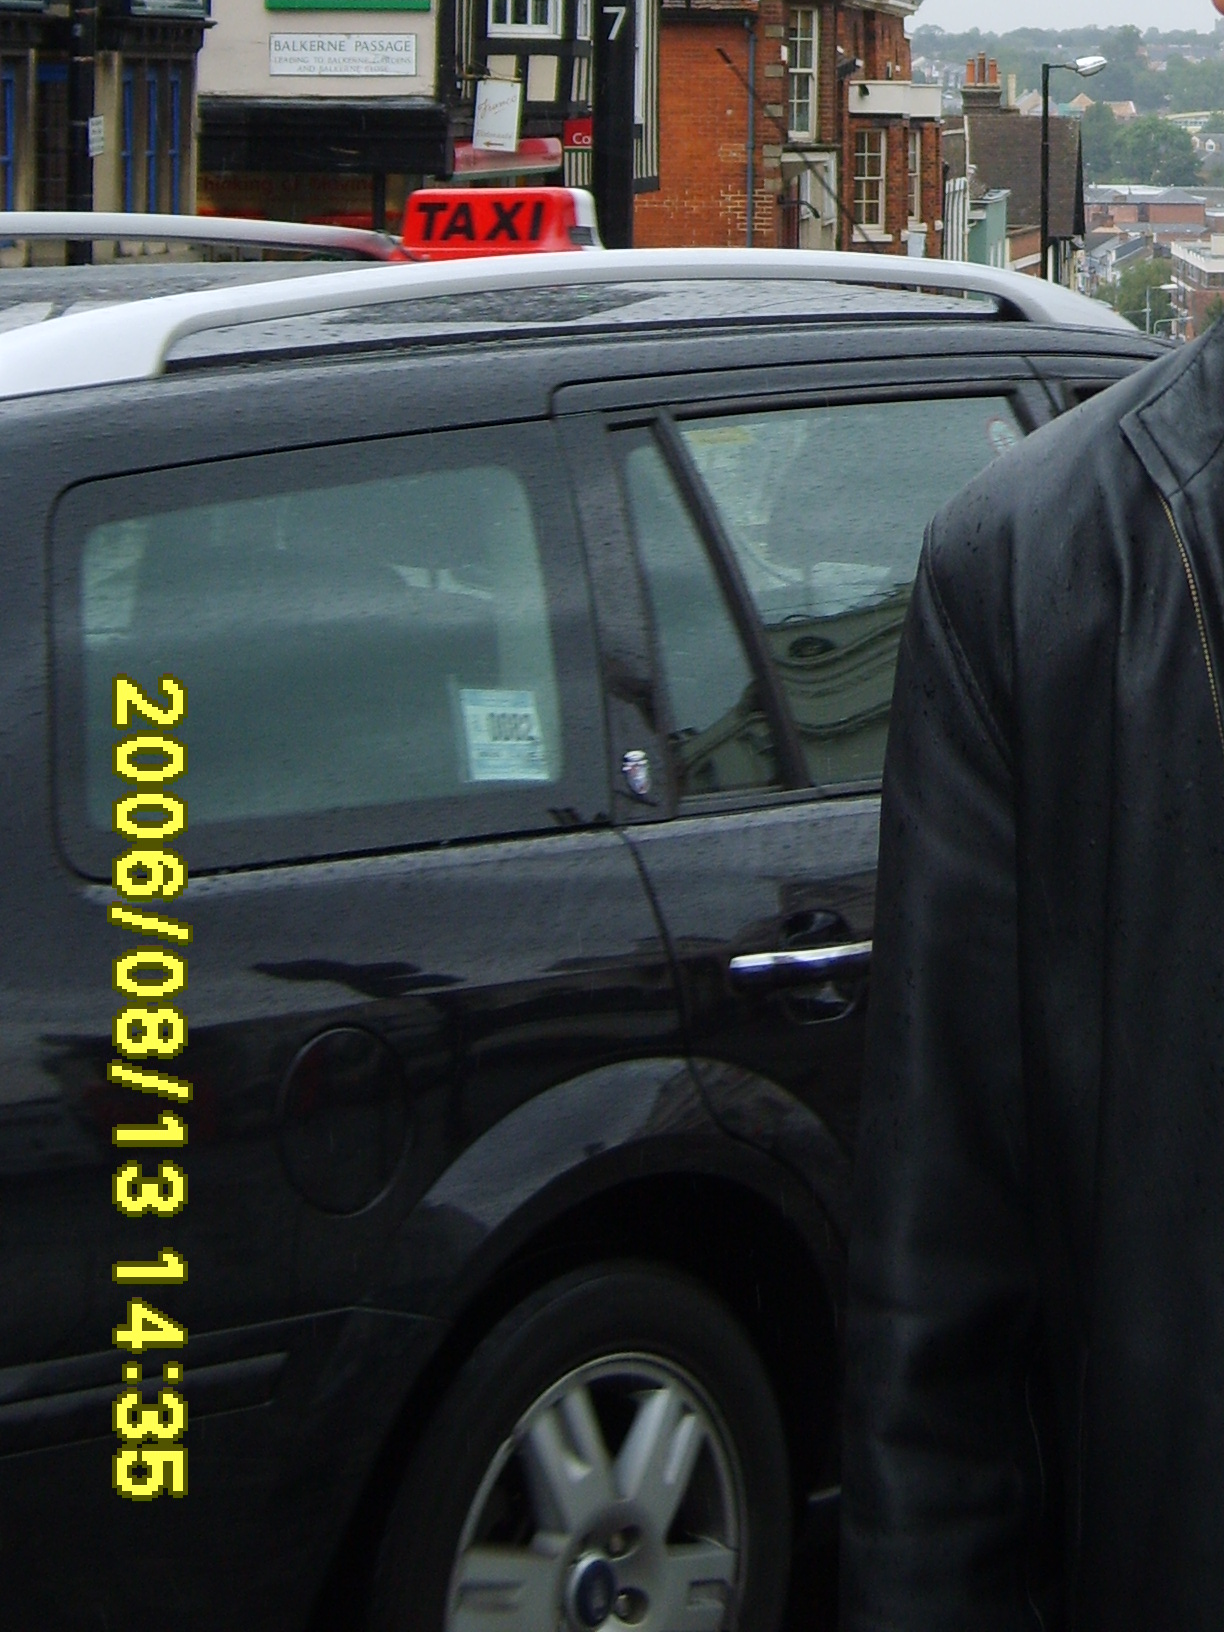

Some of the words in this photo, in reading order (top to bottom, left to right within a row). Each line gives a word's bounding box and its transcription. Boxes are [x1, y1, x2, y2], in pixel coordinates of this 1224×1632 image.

[602, 6, 627, 40] 7
[274, 40, 346, 52] BALKERNE
[354, 40, 411, 52] PASSAGE
[416, 201, 545, 242] TAXI
